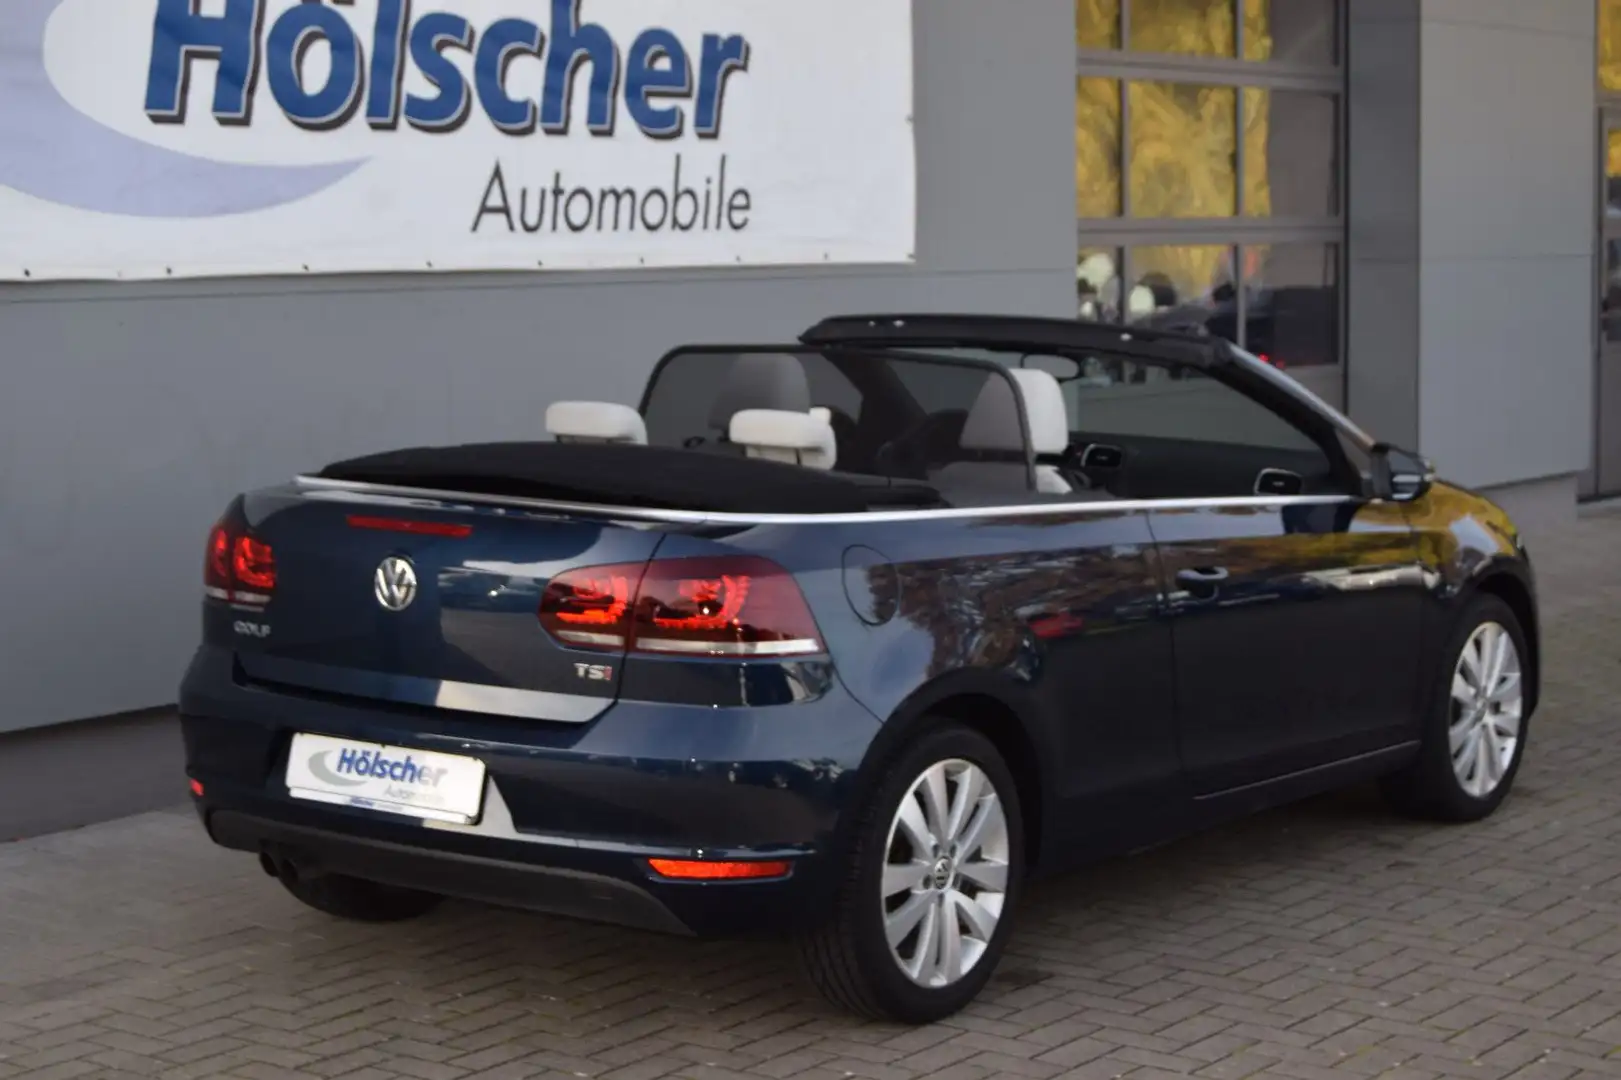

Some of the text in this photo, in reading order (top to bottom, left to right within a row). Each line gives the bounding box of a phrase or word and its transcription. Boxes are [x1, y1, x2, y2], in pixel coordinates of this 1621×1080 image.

[144, 0, 750, 139] Hölscher
[470, 152, 752, 233] Automobile
[336, 747, 449, 788] Hölscher
